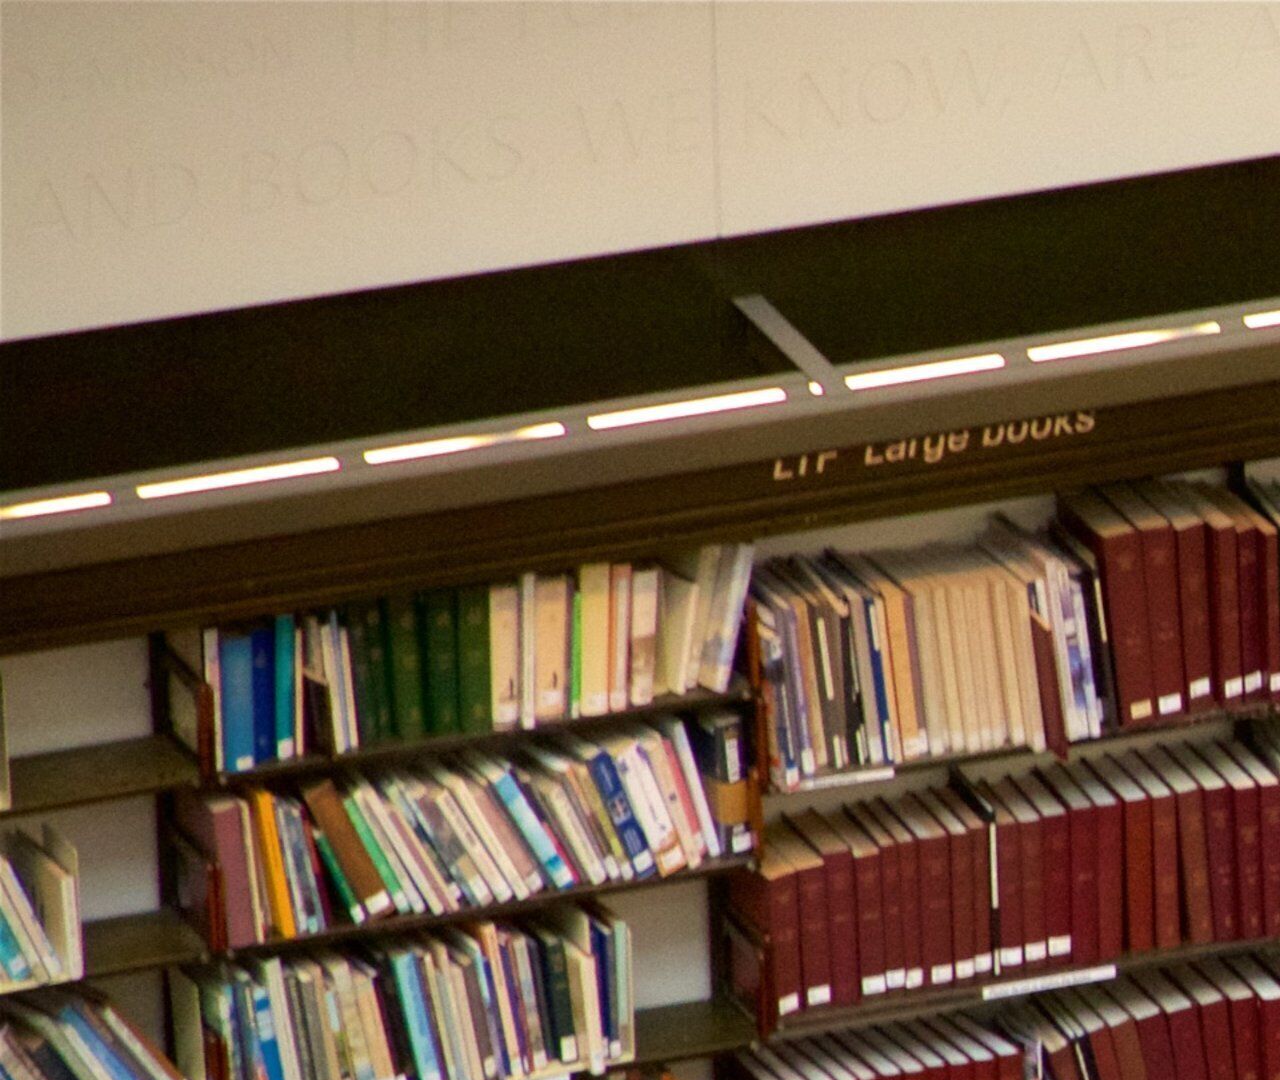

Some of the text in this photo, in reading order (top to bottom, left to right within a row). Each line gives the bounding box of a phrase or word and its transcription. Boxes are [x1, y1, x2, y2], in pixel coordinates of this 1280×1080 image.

[22, 161, 199, 241] AND
[574, 88, 703, 166] WE
[1052, 15, 1200, 94] ARE
